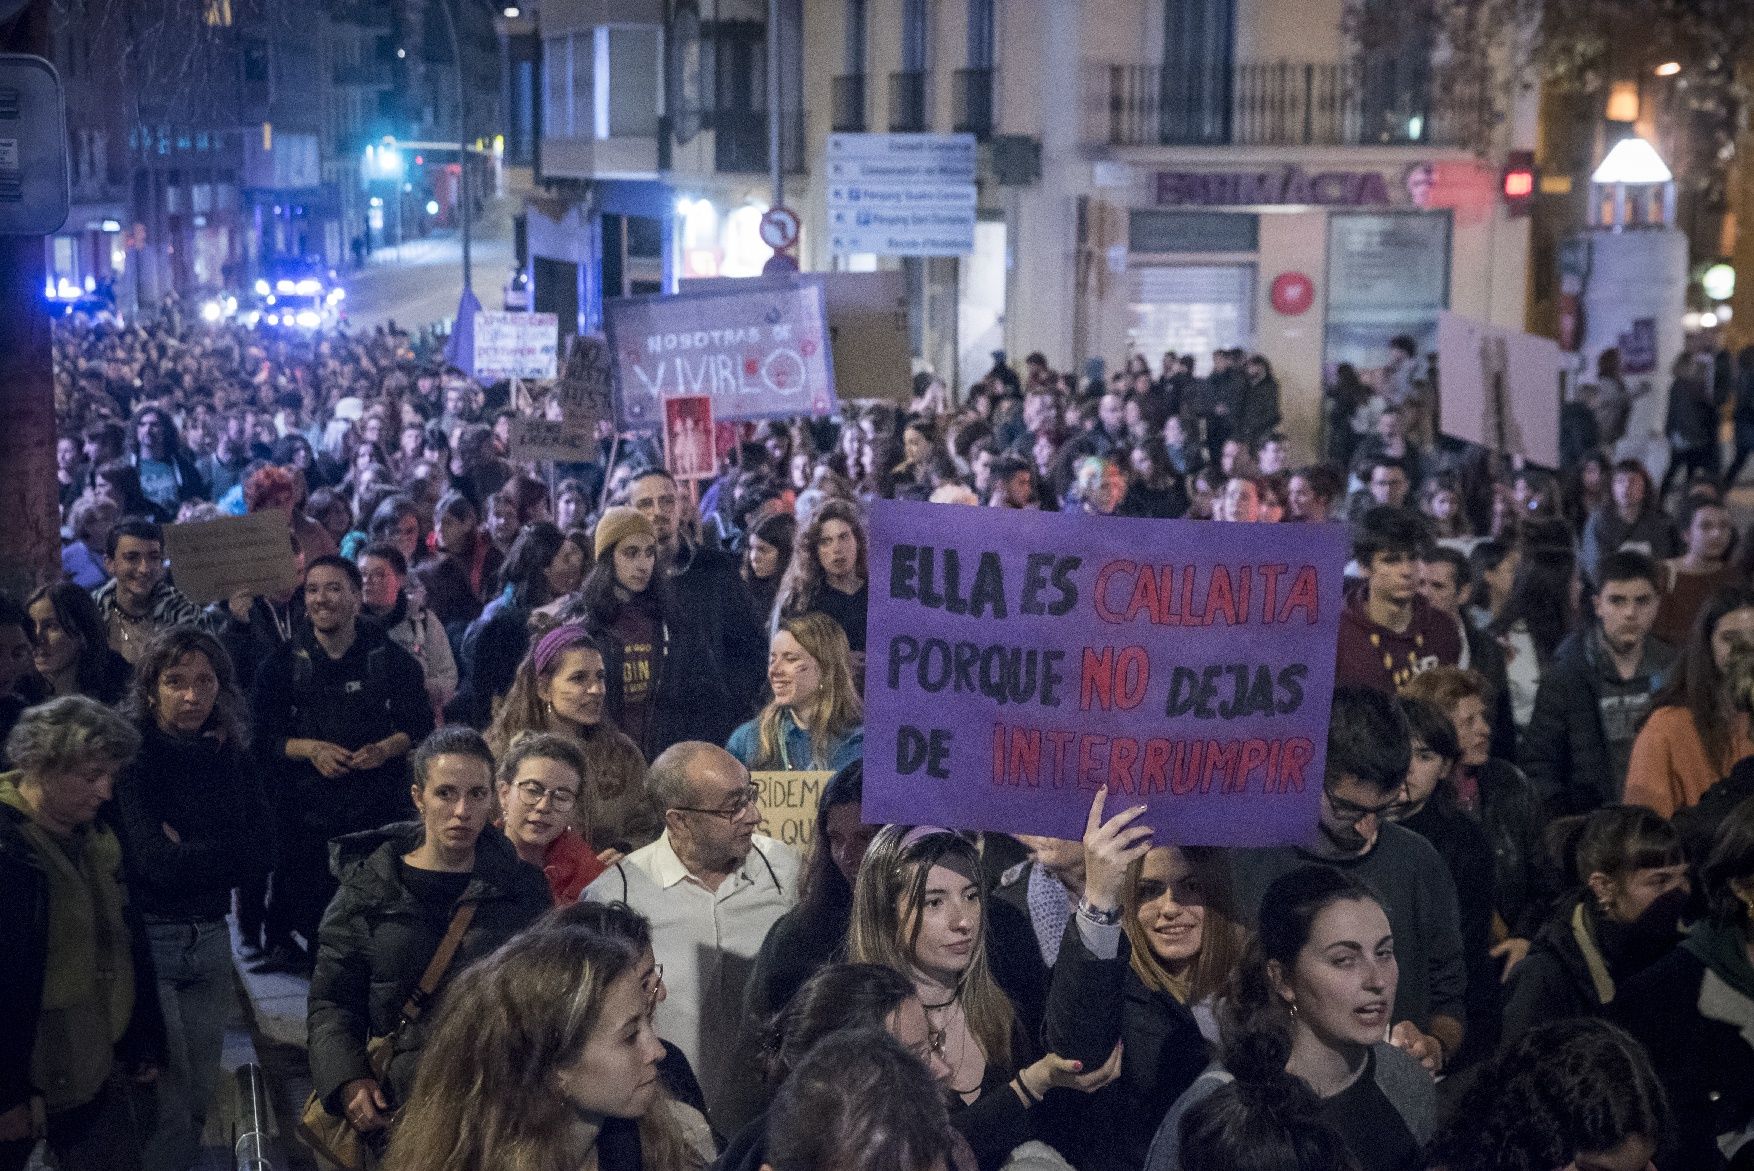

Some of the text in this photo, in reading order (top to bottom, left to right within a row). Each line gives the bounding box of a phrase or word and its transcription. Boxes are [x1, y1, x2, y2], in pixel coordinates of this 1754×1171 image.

[633, 347, 806, 397] VIVIRLO
[647, 326, 761, 353] NOSOTRAS
[889, 544, 1320, 627] ELLA ES CALLAITA
[887, 635, 1309, 720] PORQUE NO DEJAS
[896, 722, 1316, 796] DE INTERRUMPIR
